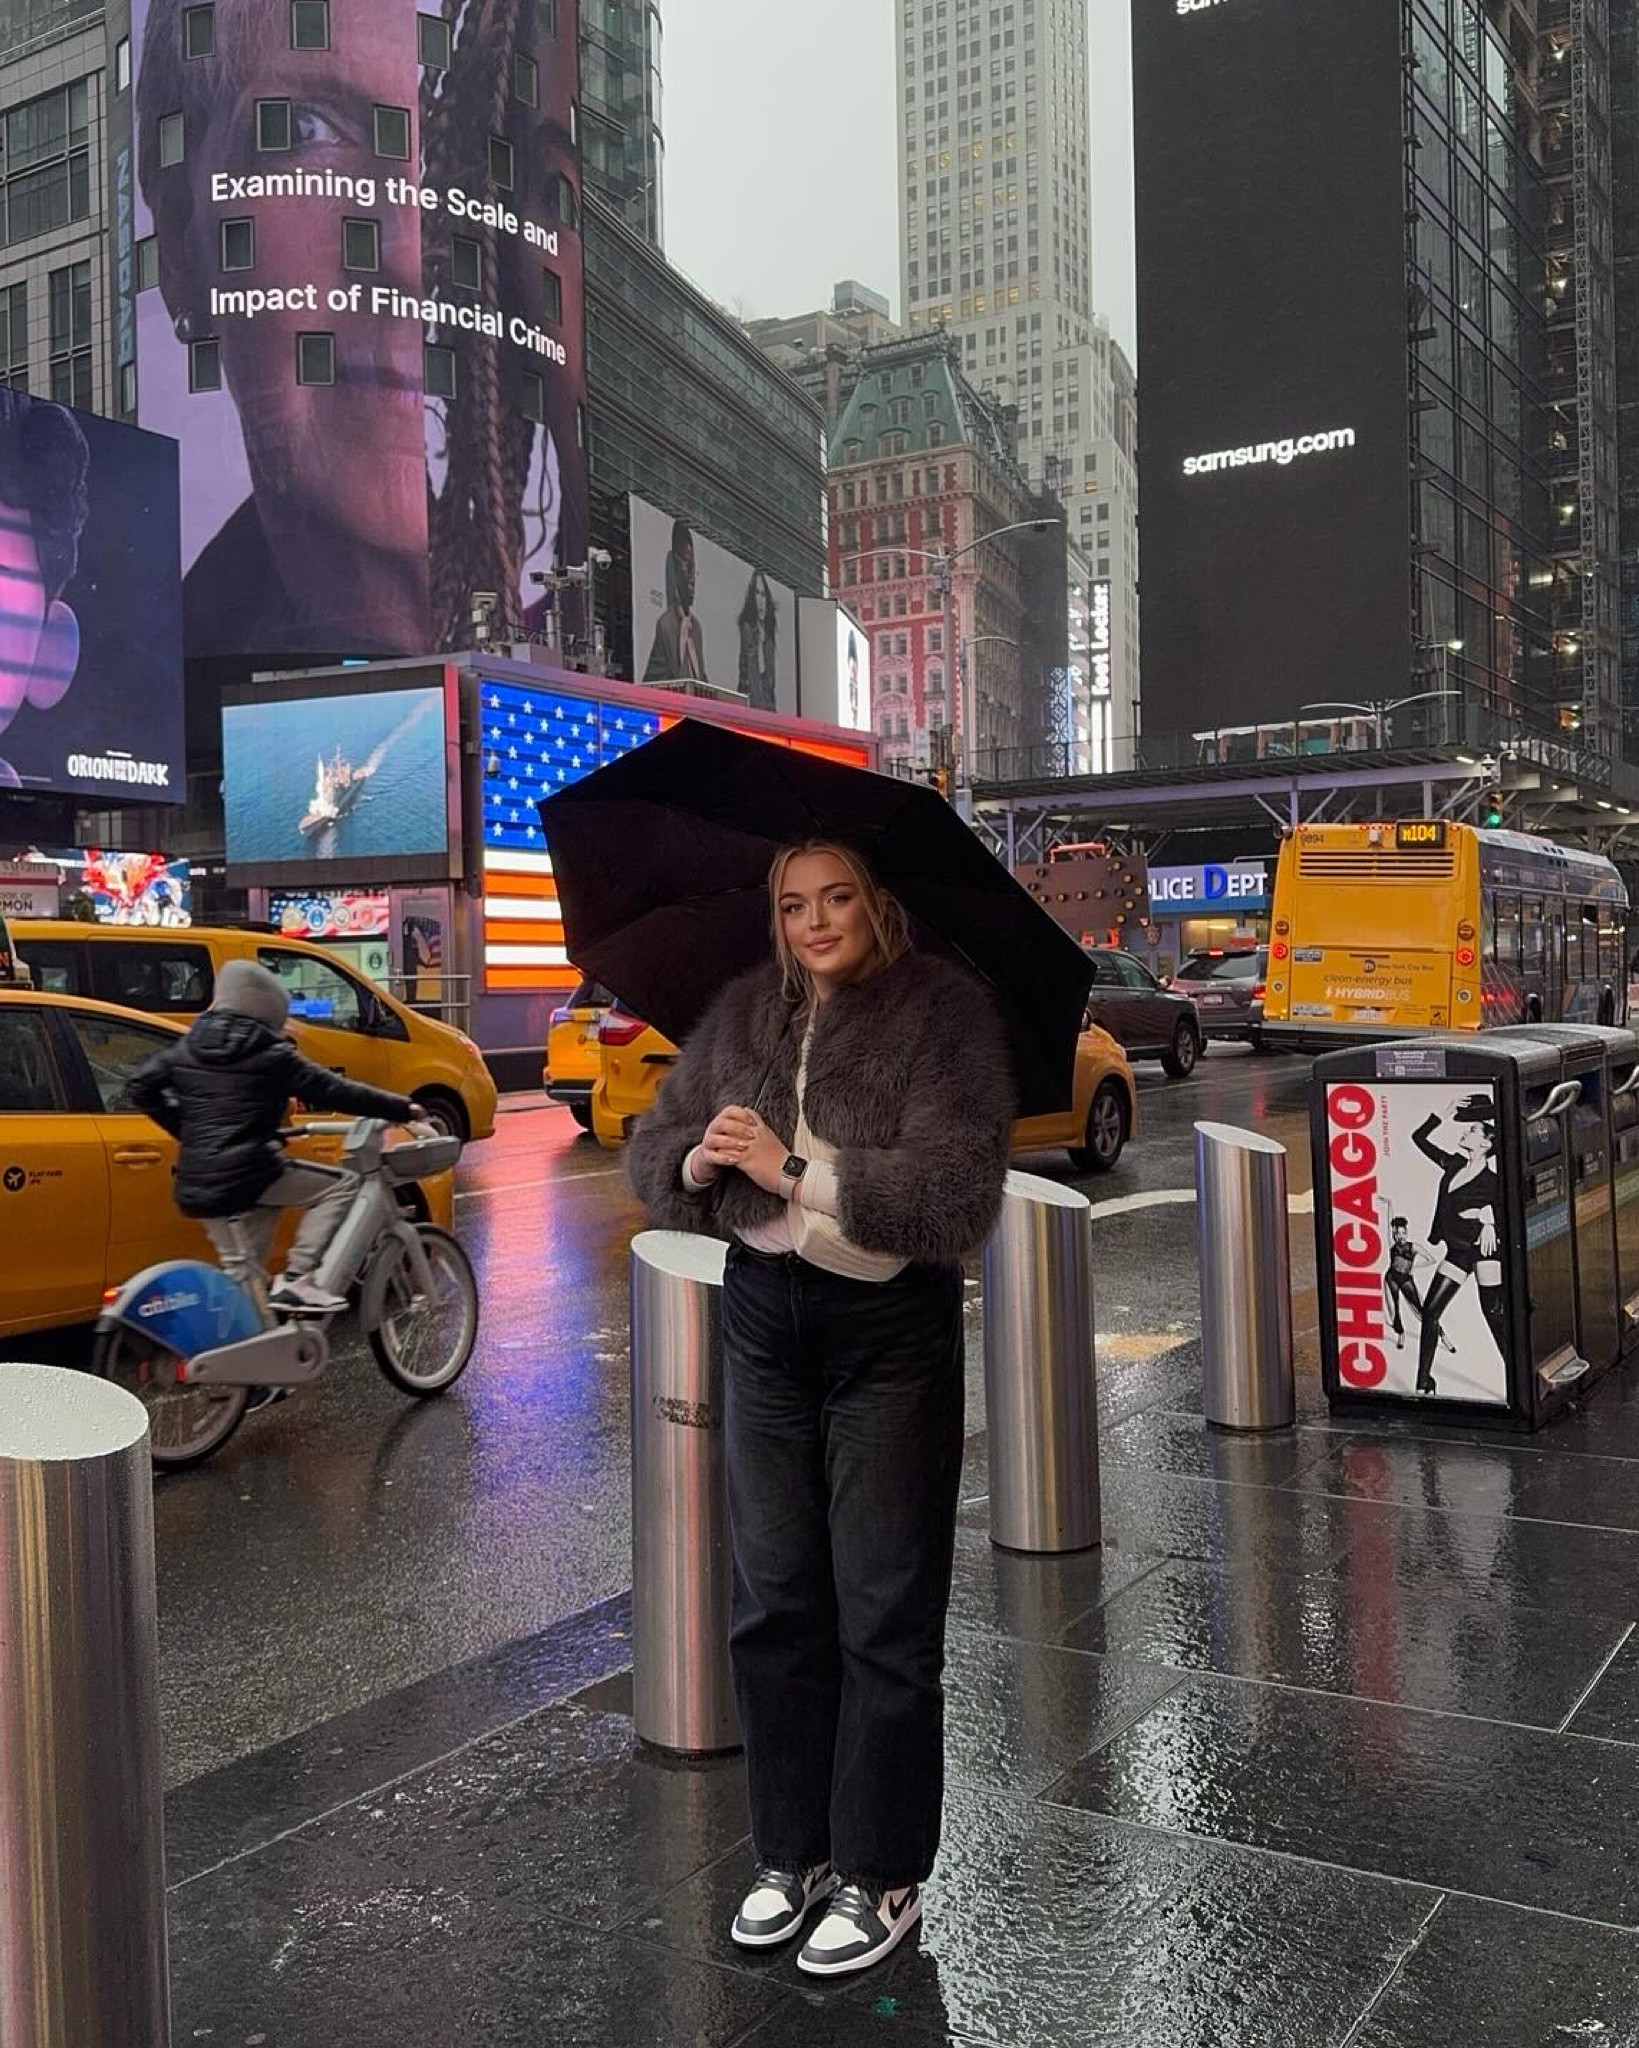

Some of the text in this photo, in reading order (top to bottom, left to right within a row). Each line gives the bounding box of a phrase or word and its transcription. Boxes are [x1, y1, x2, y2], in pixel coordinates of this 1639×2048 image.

[212, 168, 558, 257] Examining the Scale and
[117, 148, 134, 367] NASDAQ
[210, 284, 566, 367] Impact of Financial Crime
[1183, 427, 1356, 475] samsung.com
[1090, 584, 1110, 696] Foot Locker
[67, 754, 114, 781] ORION
[127, 761, 169, 786] DARK
[0, 900, 33, 912] MON
[1203, 864, 1268, 899] DEPT
[1327, 1084, 1388, 1388] CHICAGO
